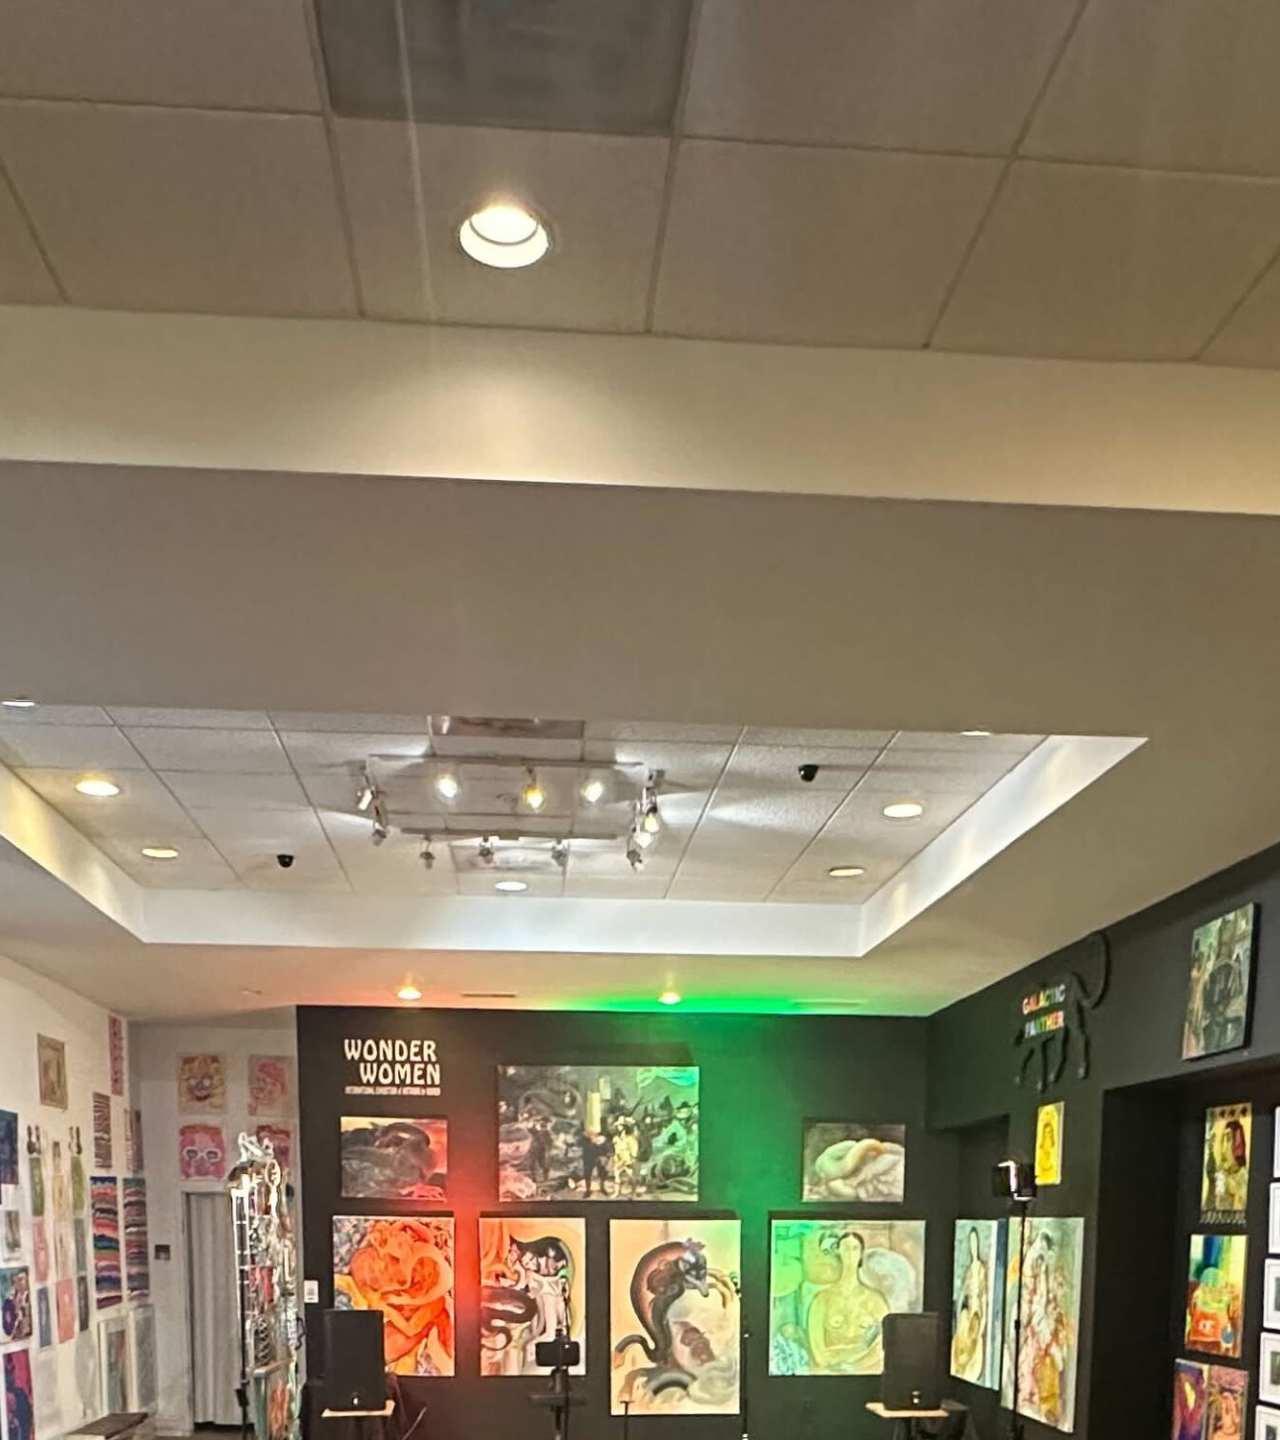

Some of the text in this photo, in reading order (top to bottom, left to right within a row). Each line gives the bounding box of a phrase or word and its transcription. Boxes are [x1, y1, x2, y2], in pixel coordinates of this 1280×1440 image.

[1023, 984, 1066, 1015] GALACTIC
[344, 1039, 437, 1062] WONDER
[360, 1062, 440, 1086] WOMEN
